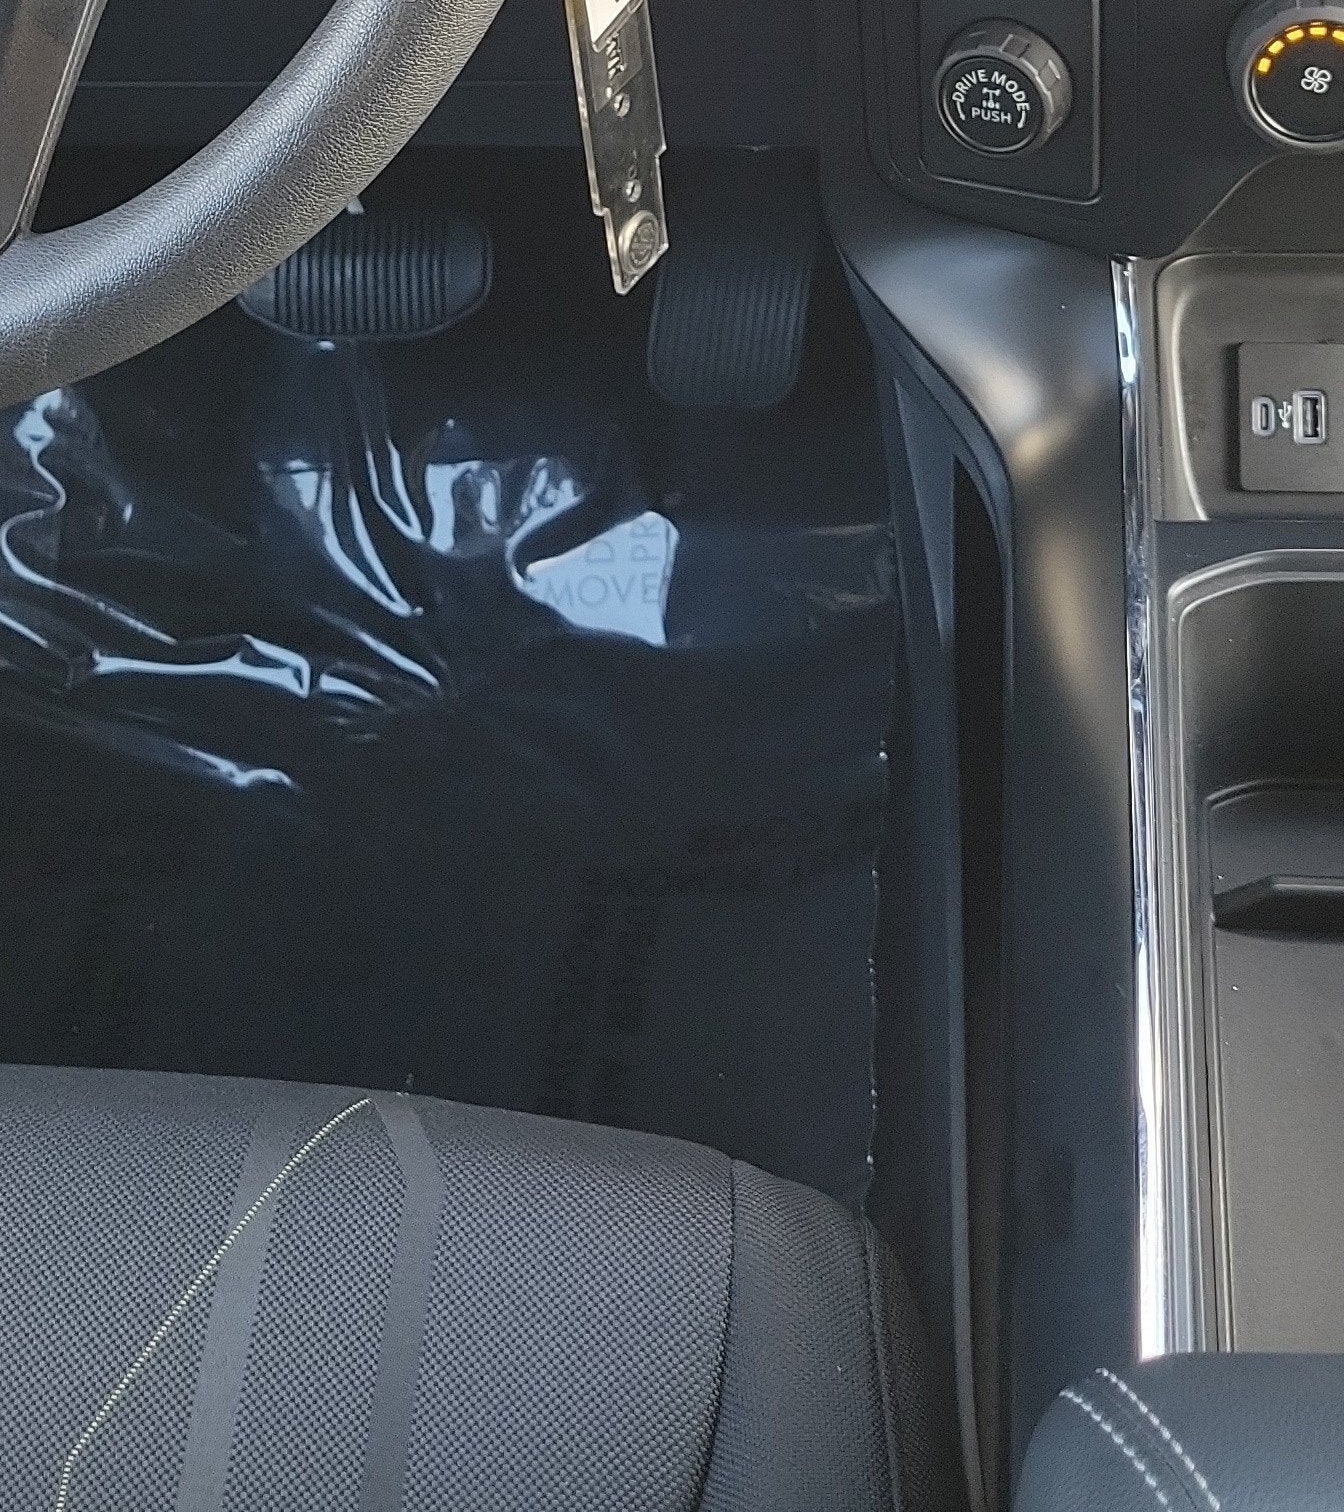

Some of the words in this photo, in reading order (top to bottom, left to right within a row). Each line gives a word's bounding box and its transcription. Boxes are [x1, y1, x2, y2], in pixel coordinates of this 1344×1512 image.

[952, 69, 990, 103] DRIVE
[991, 71, 1030, 111] MODE
[971, 106, 1012, 124] PUSH
